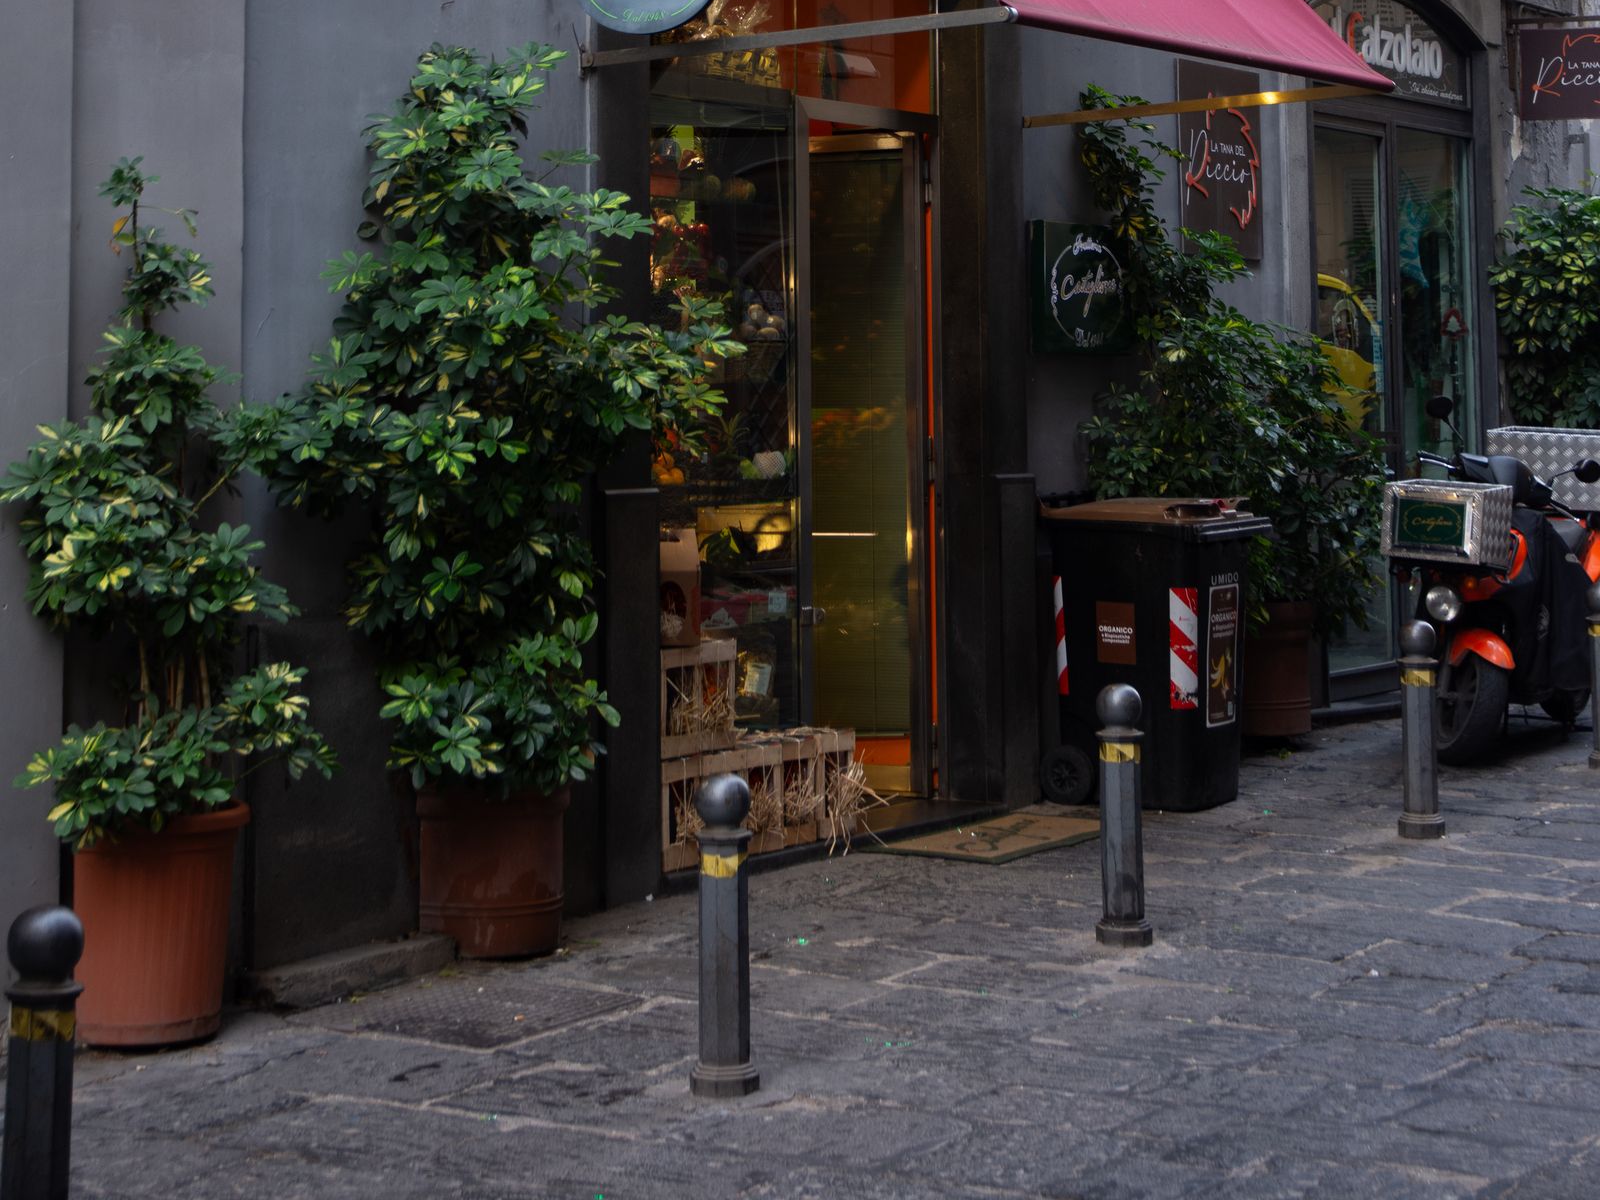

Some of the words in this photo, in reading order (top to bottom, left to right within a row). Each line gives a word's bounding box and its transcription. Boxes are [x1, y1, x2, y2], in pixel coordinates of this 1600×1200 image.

[1567, 61, 1579, 70] LA
[1210, 139, 1218, 153] LA
[1219, 142, 1235, 155] TANA
[1236, 145, 1246, 157] DEL
[1185, 129, 1251, 206] Riccio
[1211, 571, 1239, 586] UMIDO
[1210, 610, 1237, 623] ORGANICO
[1098, 625, 1133, 634] ORGANICO
